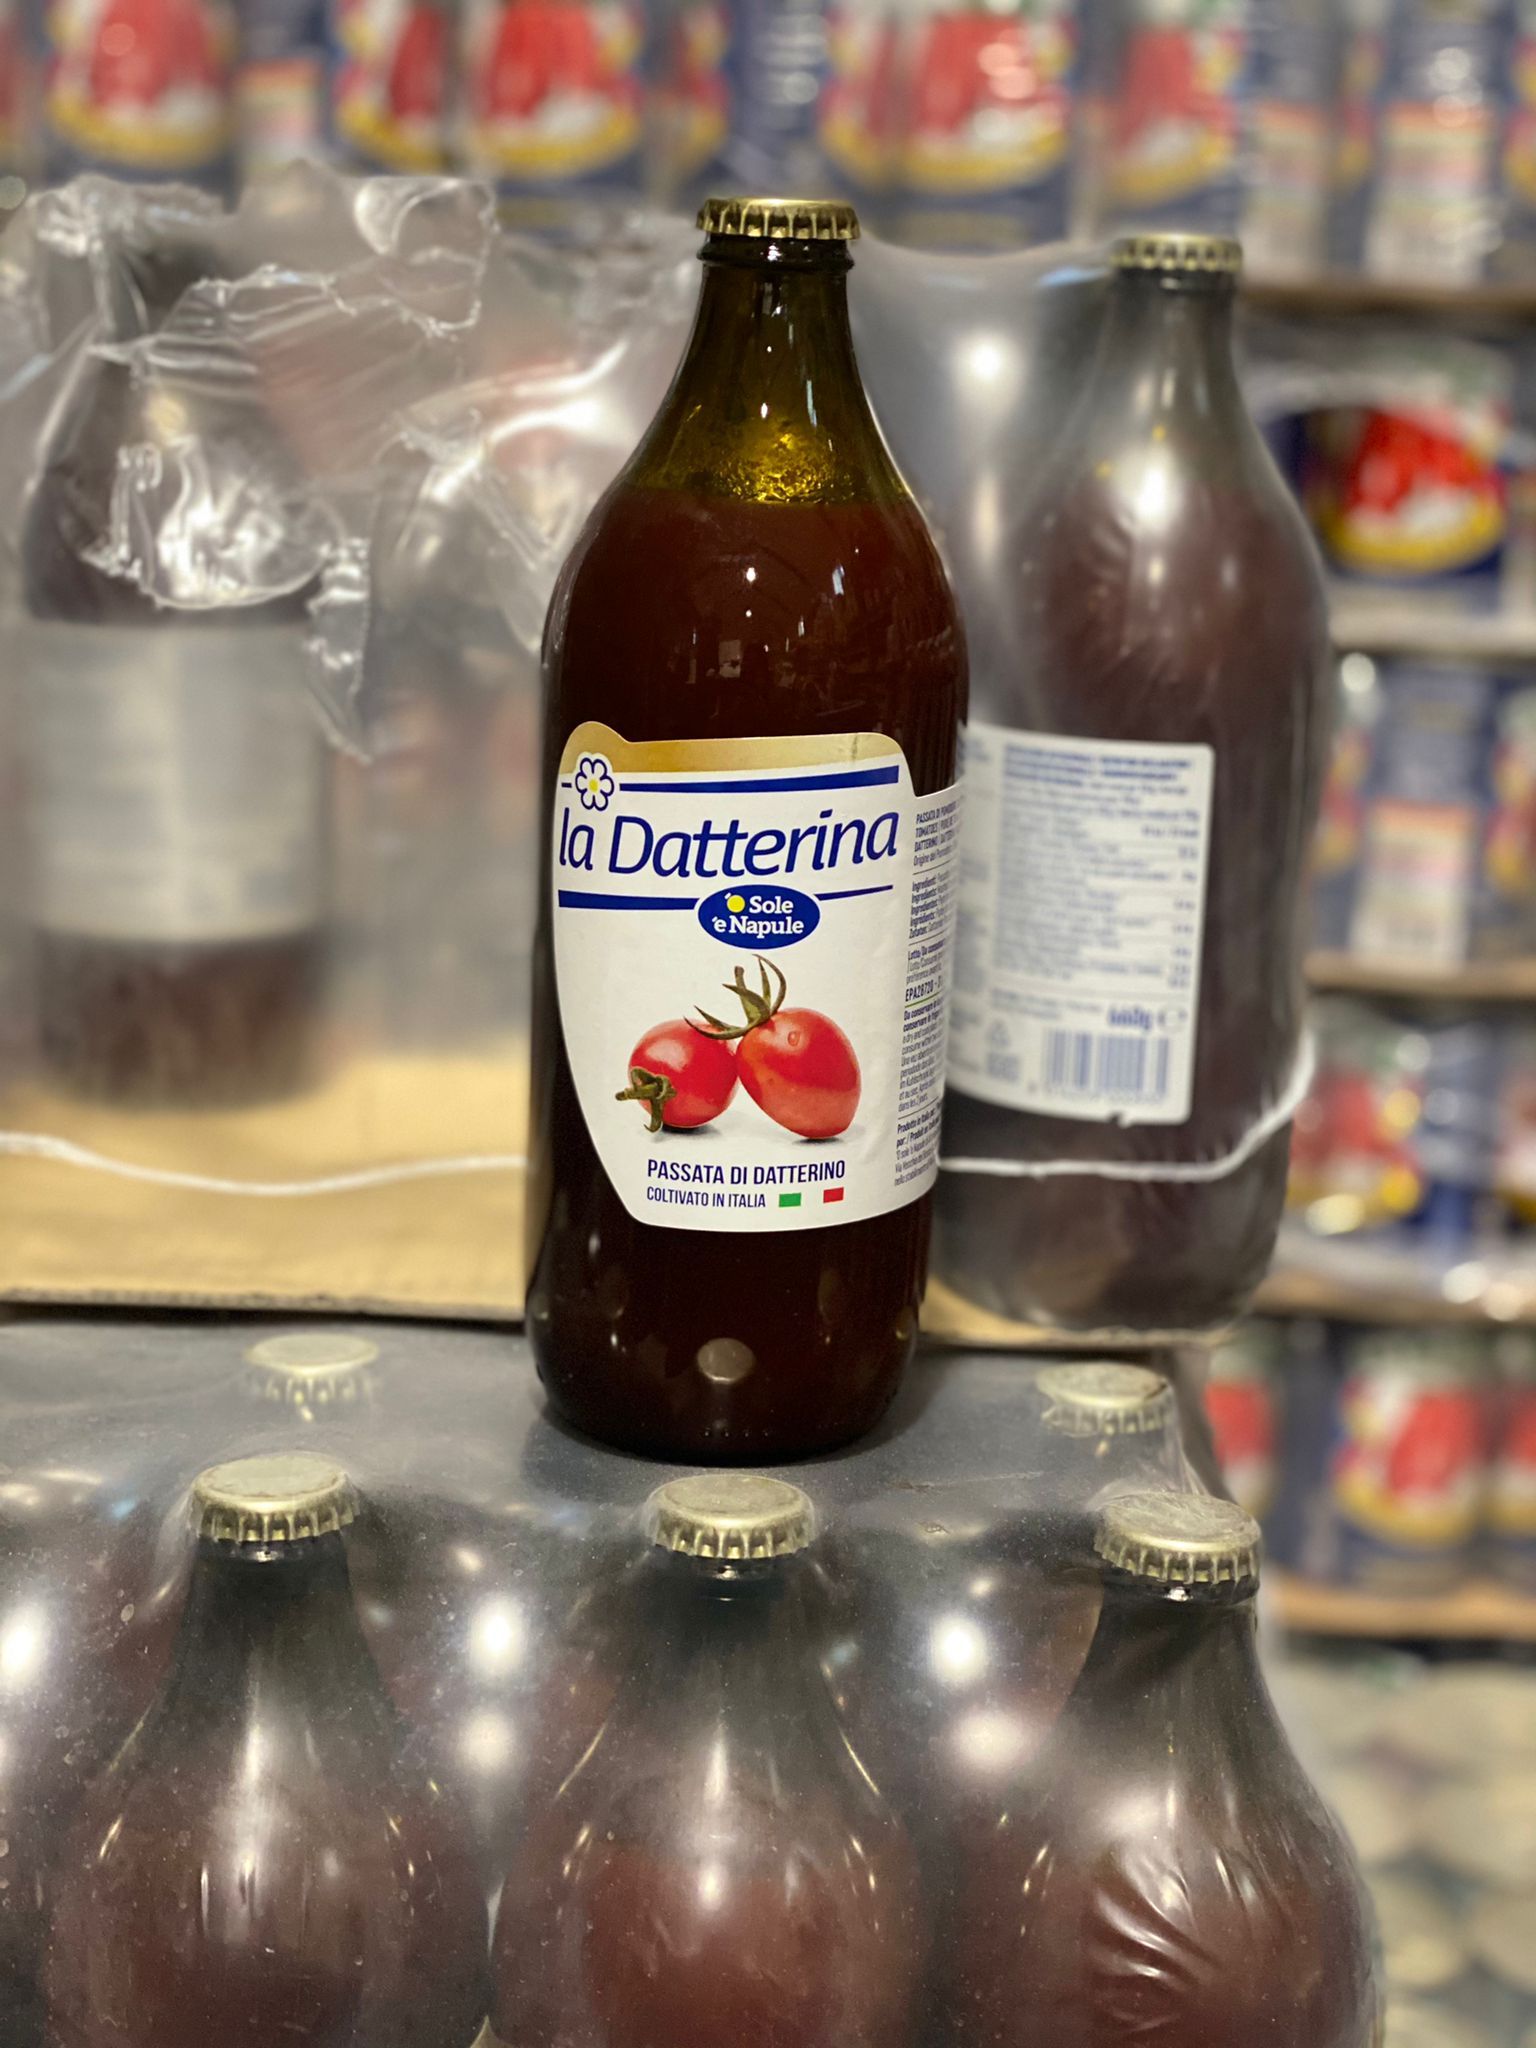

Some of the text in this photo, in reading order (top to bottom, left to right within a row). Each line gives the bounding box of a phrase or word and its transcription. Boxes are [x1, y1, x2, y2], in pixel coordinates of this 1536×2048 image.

[559, 807, 899, 878] la Datterina
[749, 896, 794, 914] Sole
[729, 916, 804, 939] Napule
[647, 1159, 846, 1185] PASSATA DI DATTERINO
[647, 1186, 766, 1208] COLTIVATO IN ITALIA
